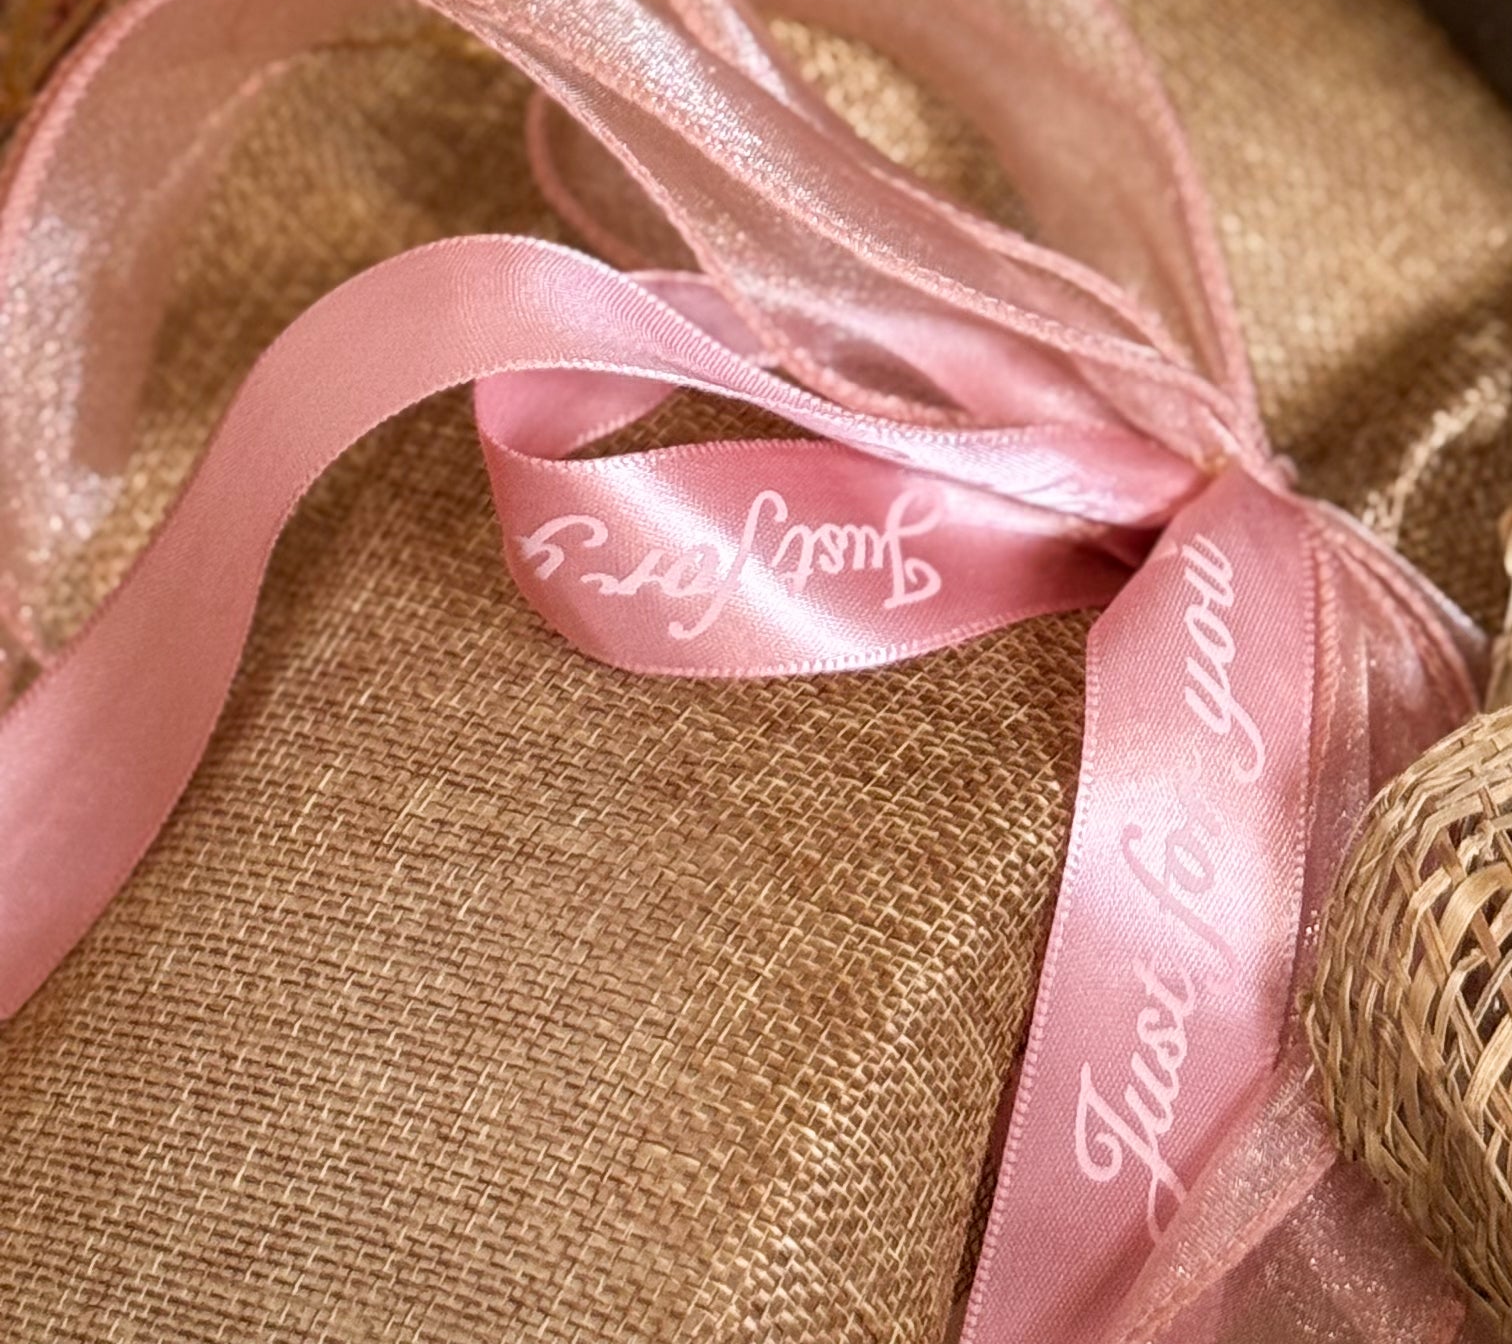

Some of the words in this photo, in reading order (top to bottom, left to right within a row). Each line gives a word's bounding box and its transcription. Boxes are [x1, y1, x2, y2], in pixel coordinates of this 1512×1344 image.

[579, 489, 790, 640] for
[772, 489, 946, 609] Just
[1074, 956, 1198, 1250] Just
[1181, 533, 1266, 784] you
